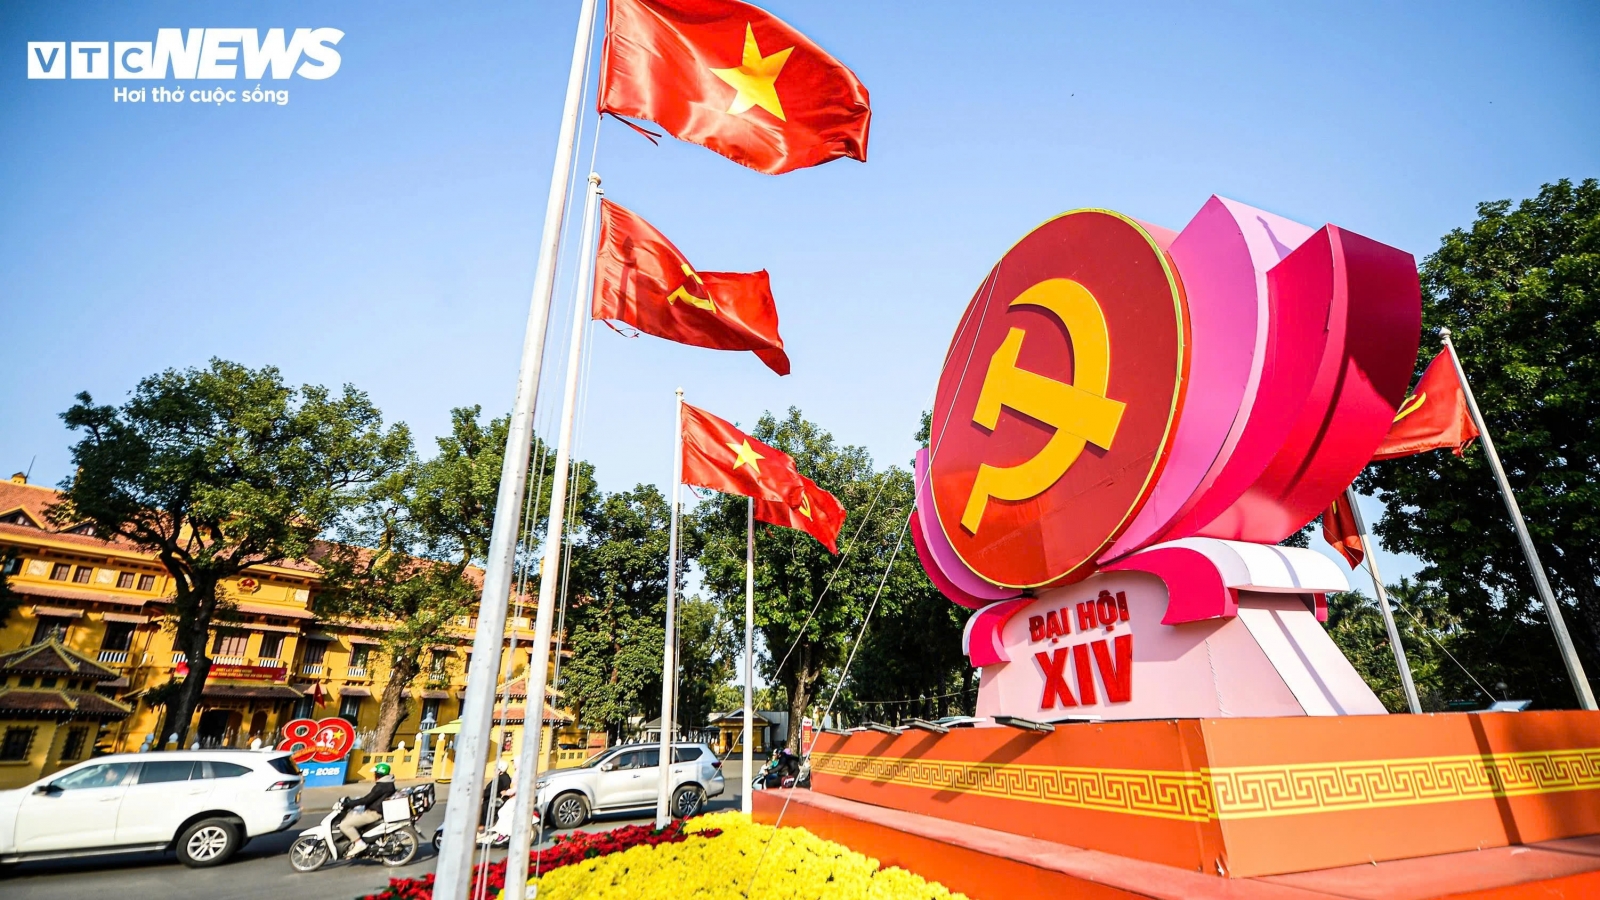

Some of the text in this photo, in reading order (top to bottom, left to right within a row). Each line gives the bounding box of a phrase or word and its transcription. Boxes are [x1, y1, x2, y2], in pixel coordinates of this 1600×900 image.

[1028, 589, 1131, 643] ĐẠI HỘI
[1034, 633, 1134, 710] XIV
[276, 717, 356, 763] 80
[315, 767, 341, 777] 2025
